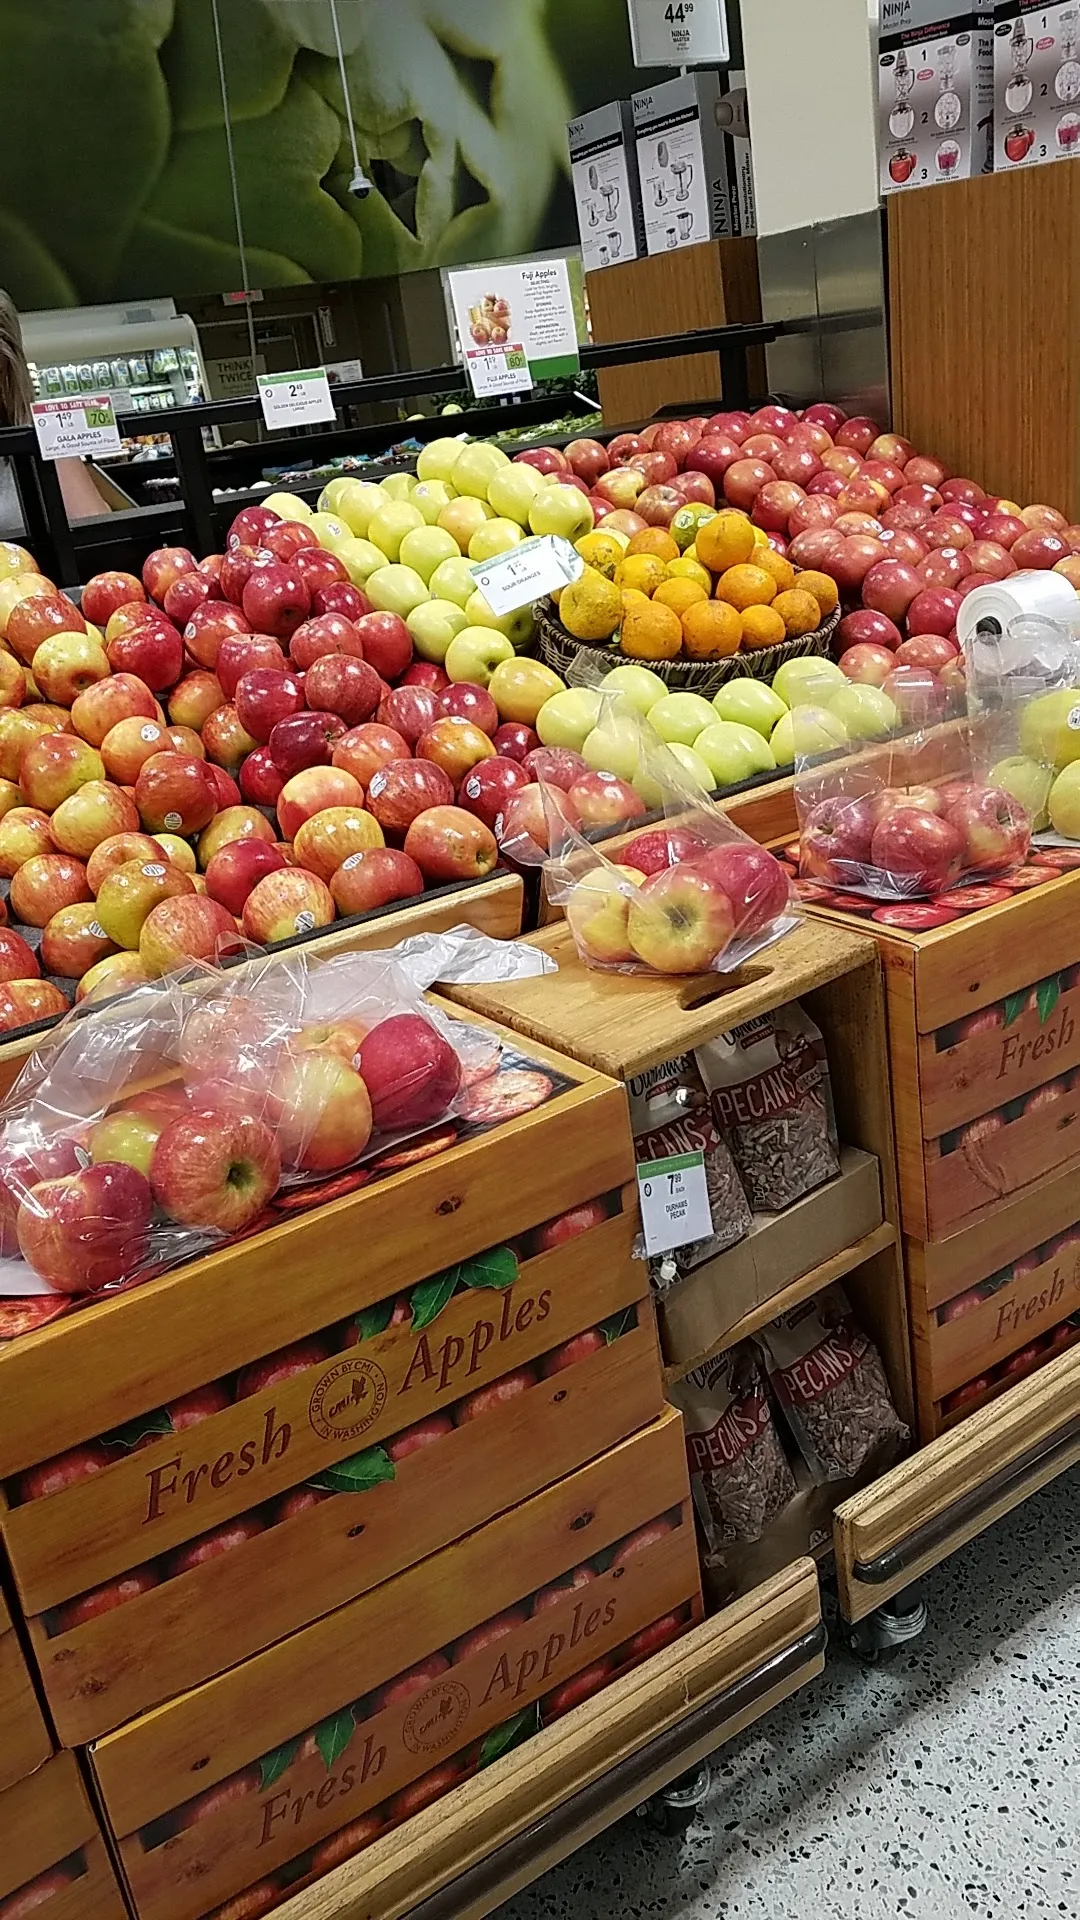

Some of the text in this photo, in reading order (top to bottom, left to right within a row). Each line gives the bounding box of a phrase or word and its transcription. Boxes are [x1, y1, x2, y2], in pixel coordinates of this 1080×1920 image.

[882, 0, 910, 19] NINJA
[1042, 16, 1046, 28] 1
[921, 50, 926, 61] 1
[1040, 84, 1048, 96] 2
[634, 96, 654, 112] NINJA
[921, 112, 928, 124] 2
[568, 124, 584, 138] NINJA
[1040, 144, 1047, 156] 3
[921, 168, 928, 180] 3
[713, 178, 728, 234] NINJA
[522, 268, 556, 280] Fuji Apples
[219, 371, 252, 384] TWICE
[57, 430, 102, 443] GALA APPLES
[67, 440, 80, 449] Good
[81, 439, 98, 448] Source
[996, 1005, 1074, 1080] Fresh
[716, 1066, 796, 1125] PECANS
[666, 1200, 688, 1212] DURHAMS
[670, 1208, 686, 1220] PECAN
[992, 1267, 1065, 1342] Fresh
[396, 1288, 552, 1396] Apples
[780, 1338, 853, 1401] PECANS
[312, 1361, 374, 1412] GROWN BY CMI
[320, 1382, 384, 1440] IN WASHINGTON
[692, 1404, 758, 1468] PECANS
[142, 1406, 292, 1525] Fresh
[478, 1598, 616, 1708] Apples
[256, 1733, 388, 1850] Fresh
